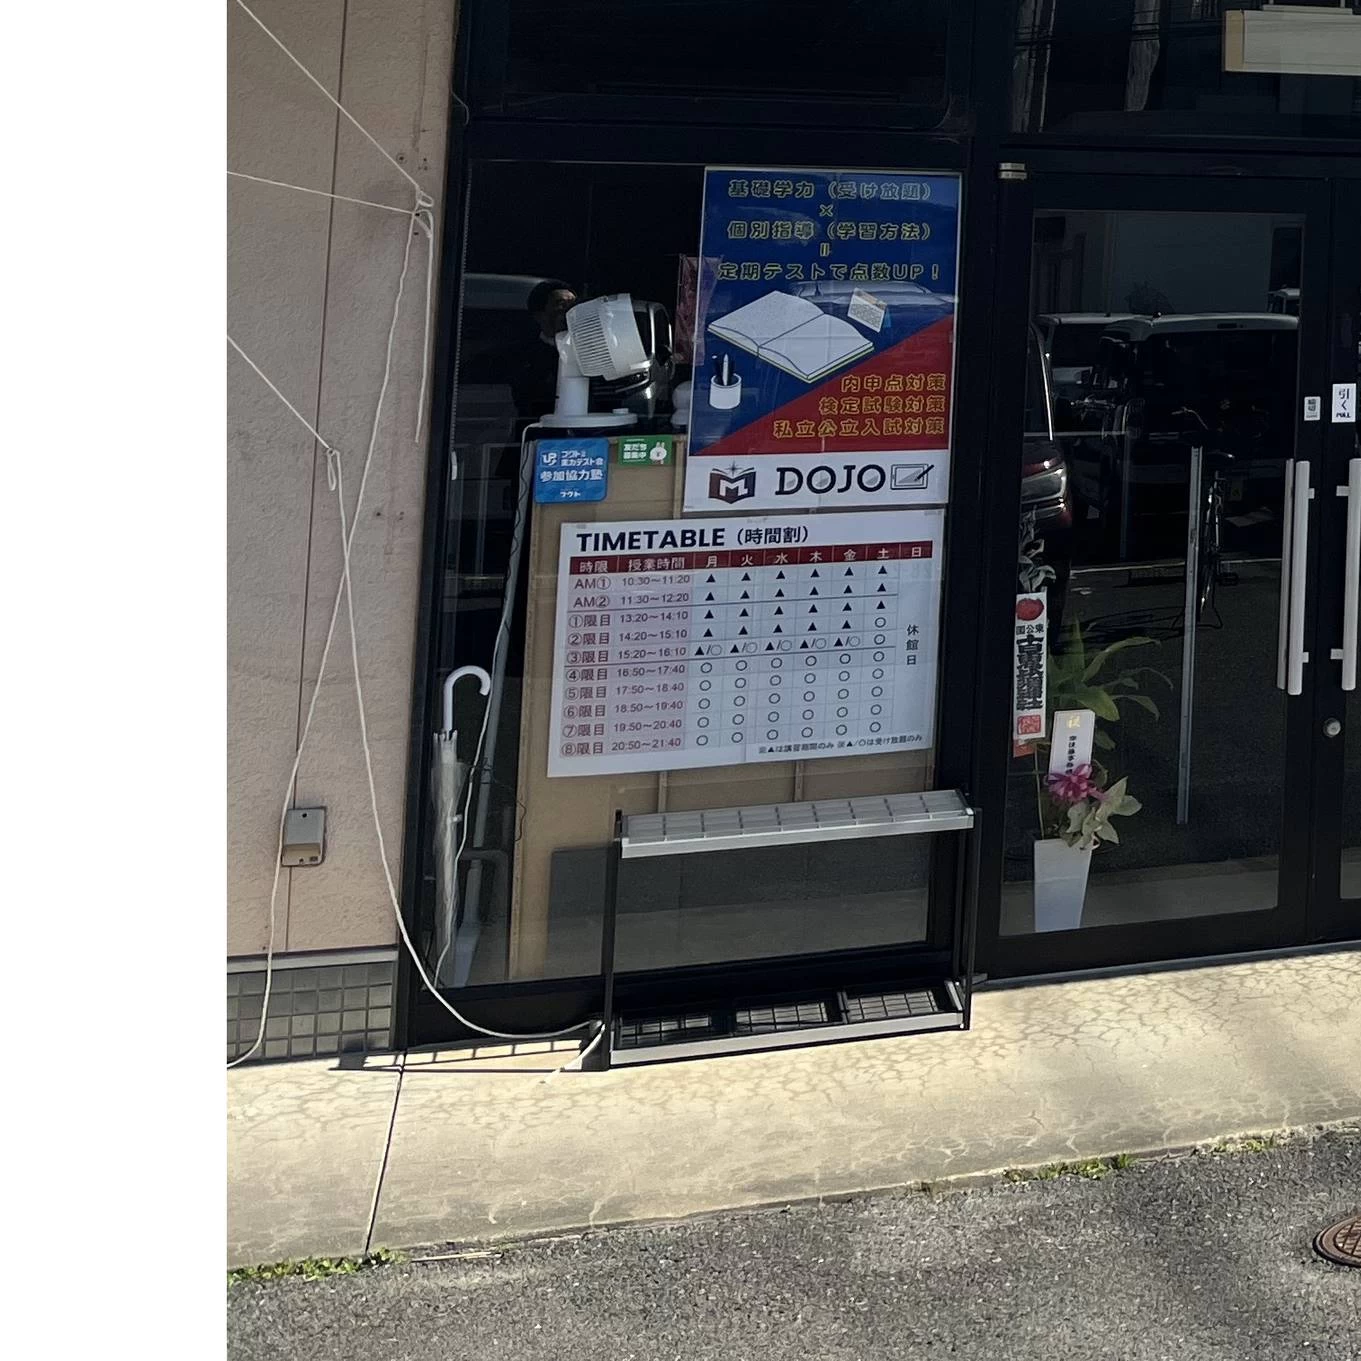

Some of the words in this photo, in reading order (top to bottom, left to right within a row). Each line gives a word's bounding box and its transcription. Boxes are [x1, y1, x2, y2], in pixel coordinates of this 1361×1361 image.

[727, 221, 932, 240] 個別指導（学習方法）
[841, 374, 947, 392] 内申点対策
[819, 396, 946, 414] 検定試験対策
[773, 417, 945, 438] 私立公立入試対策
[540, 468, 603, 483] 参加協力塾
[775, 463, 886, 496] DOJO
[576, 528, 726, 552] TIMETABLE
[579, 559, 609, 573] 時限
[628, 557, 686, 572] 授業時間
[706, 555, 718, 568] 月
[741, 554, 754, 566] 火
[775, 552, 788, 565] 水
[809, 551, 823, 562] 木
[843, 548, 857, 561] 金
[877, 547, 890, 560] 土
[911, 546, 922, 558] 日
[906, 624, 920, 666] 休館日
